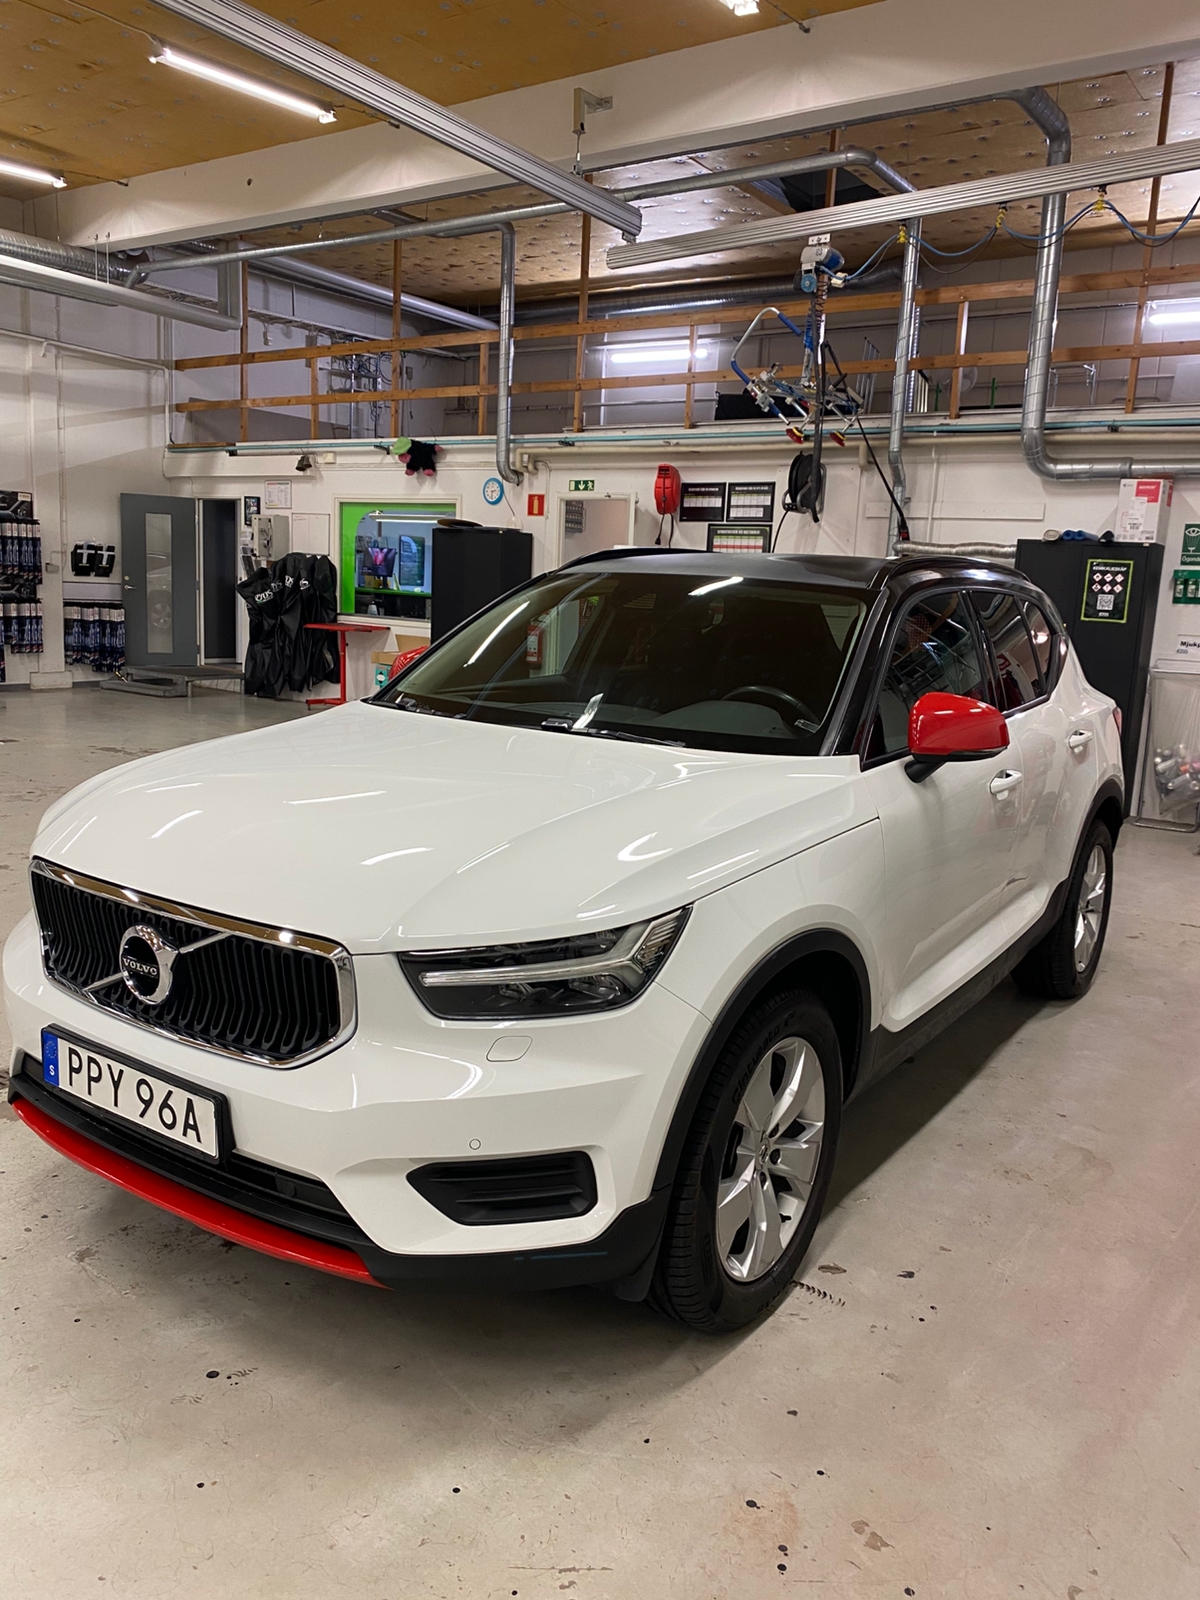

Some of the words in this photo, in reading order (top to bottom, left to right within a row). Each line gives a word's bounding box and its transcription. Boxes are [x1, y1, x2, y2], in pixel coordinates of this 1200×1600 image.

[122, 957, 158, 976] VOLVO
[49, 1064, 55, 1076] S
[68, 1046, 124, 1108] PPY
[136, 1077, 202, 1144] 96A
